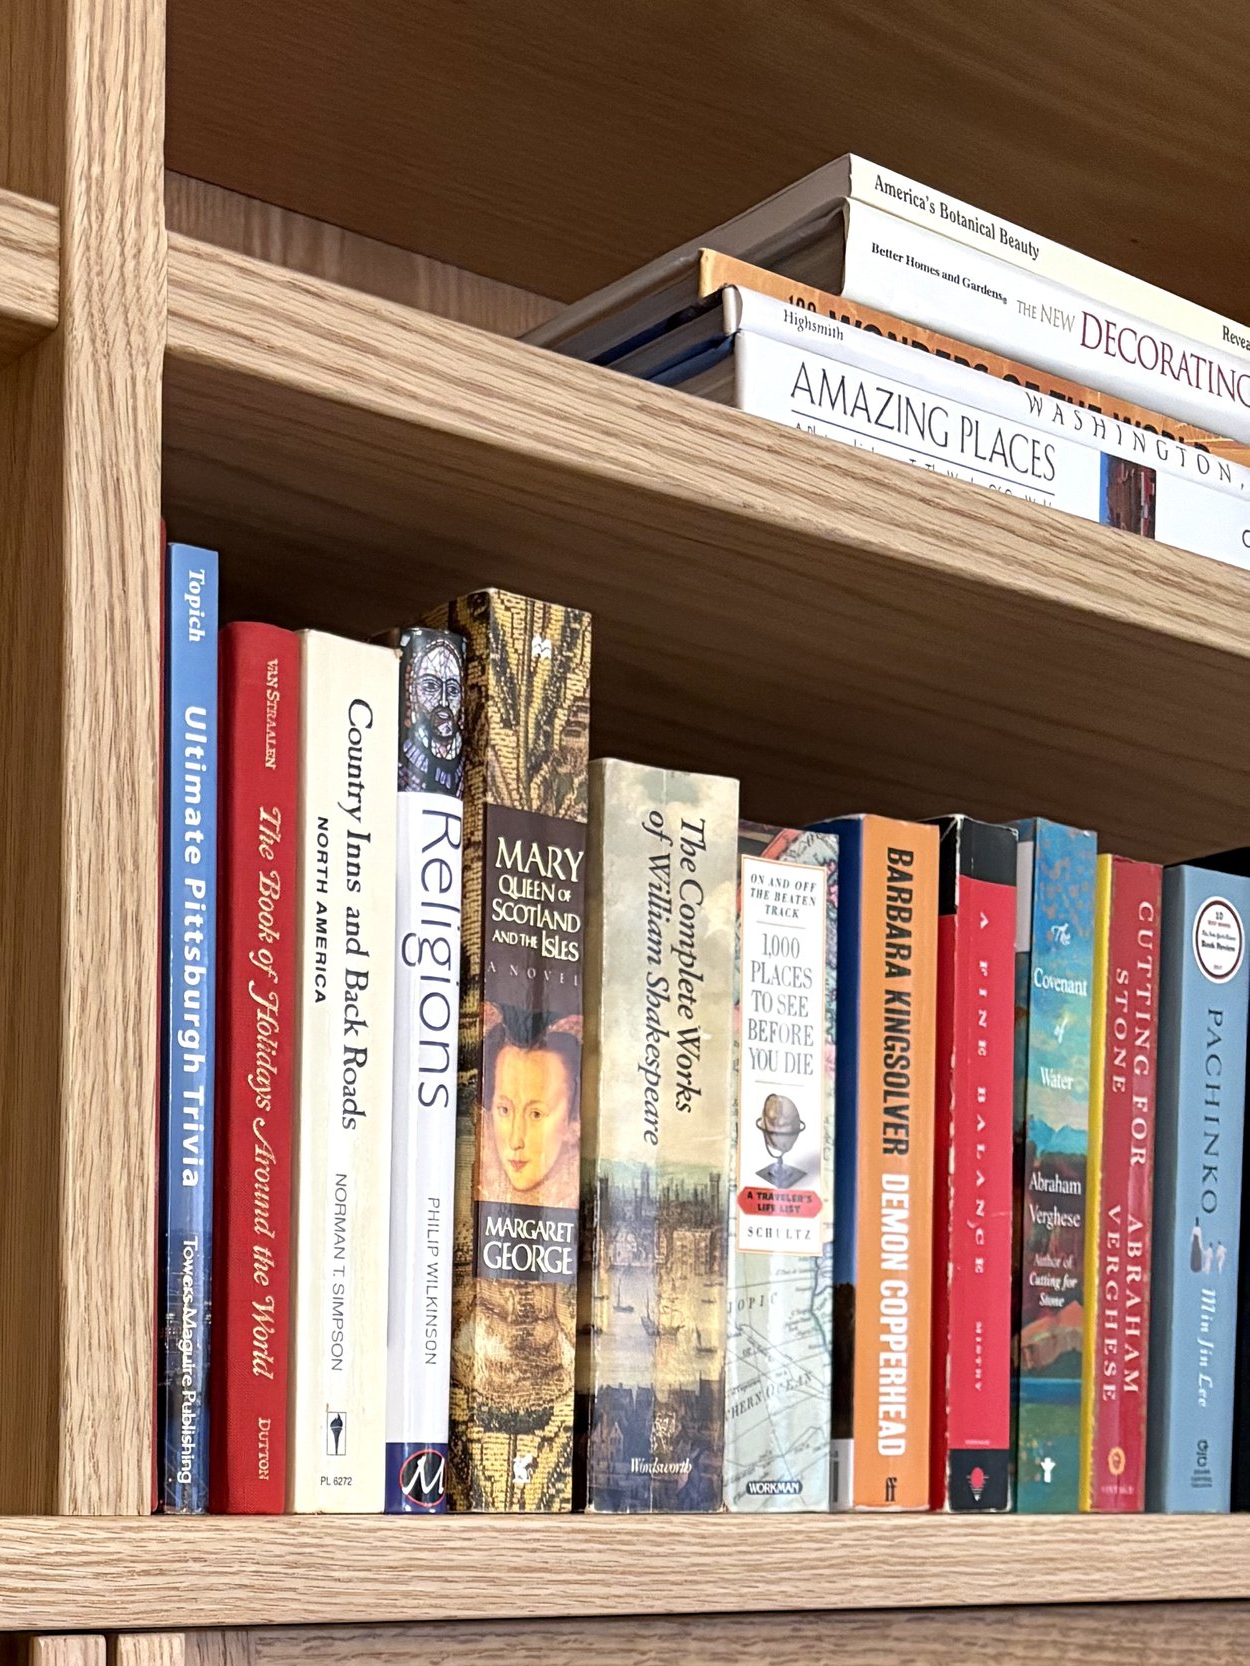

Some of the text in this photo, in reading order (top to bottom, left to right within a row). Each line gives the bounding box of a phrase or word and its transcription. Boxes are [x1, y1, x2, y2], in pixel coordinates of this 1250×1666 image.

[875, 174, 1040, 261] America's Botanical Beauty
[871, 242, 904, 263] Better
[906, 255, 940, 279] Homes
[941, 268, 961, 285] and
[783, 308, 845, 341] Highsmith
[1017, 299, 1038, 320] THE
[1041, 304, 1076, 333] NEW
[790, 361, 949, 448] AMAZING
[960, 415, 1056, 482] PLACES
[1025, 391, 1245, 490] WASHINGTON,
[184, 568, 207, 643] Topich
[494, 836, 585, 883] MARY
[498, 874, 572, 902] QUEEN OF
[750, 873, 818, 893] ON AND OFF
[750, 887, 817, 906] THE BEATEN
[315, 816, 329, 1004] NORTH AMERICA
[337, 698, 374, 1131] Country Inns and Back Roads
[491, 897, 581, 934] SCOTLAND
[765, 904, 800, 919] TRACK
[177, 705, 208, 1187] Ultimate Pittsburgh Trivia
[491, 929, 580, 962] AND THE ISLES
[762, 933, 800, 959] 1,000
[1051, 922, 1072, 946] The
[401, 808, 462, 1108] Religions
[487, 961, 579, 987] A NOVEL
[670, 816, 706, 1114] The Complete Works
[750, 960, 813, 990] PLACES
[636, 810, 674, 1147] of William Shakespeare
[1033, 966, 1088, 998] Covenant
[751, 989, 810, 1018] TO SEE
[882, 845, 915, 1157] BARBARA KINGSOLVER
[747, 1018, 814, 1047] BEFORE
[1054, 1017, 1068, 1044] of
[1112, 967, 1129, 1093] STONE
[1130, 900, 1154, 1166] CUTTING FOR
[748, 1046, 814, 1076] YOU DIE
[246, 805, 282, 1380] The Book of Holidays Around the World
[974, 911, 990, 1275] A FINE BALANCE
[1040, 1065, 1075, 1092] Water
[1200, 1007, 1224, 1215] PACHINKO
[747, 1191, 813, 1204] A TRAVELER'S
[1029, 1172, 1082, 1196] Abraham
[757, 1203, 801, 1213] LIFE LIST
[1028, 1203, 1082, 1229] Verghese
[484, 1216, 575, 1244] MARGARET
[747, 1226, 811, 1241] SCHULTZ
[330, 1173, 348, 1371] NORMAN T. SIMPSON
[482, 1240, 574, 1276] GEORGE
[1033, 1252, 1074, 1270] Author of
[424, 1197, 441, 1365] PHILIP WILKINSON
[1029, 1272, 1078, 1291] Cutting for
[877, 1172, 910, 1456] DEMON COPPERHEAD
[1039, 1293, 1065, 1308] Stone
[1102, 1203, 1122, 1401] VERGHESE
[1124, 1213, 1143, 1393] ABRAHAM
[177, 1235, 198, 1484] Towers Maguire Publishing
[1197, 1287, 1216, 1407] Min Jin Lee
[258, 1417, 271, 1481] DUTTON
[630, 1456, 693, 1475] Wordsworth
[320, 1476, 352, 1486] PL 6272
[748, 1481, 800, 1494] WORKMAN
